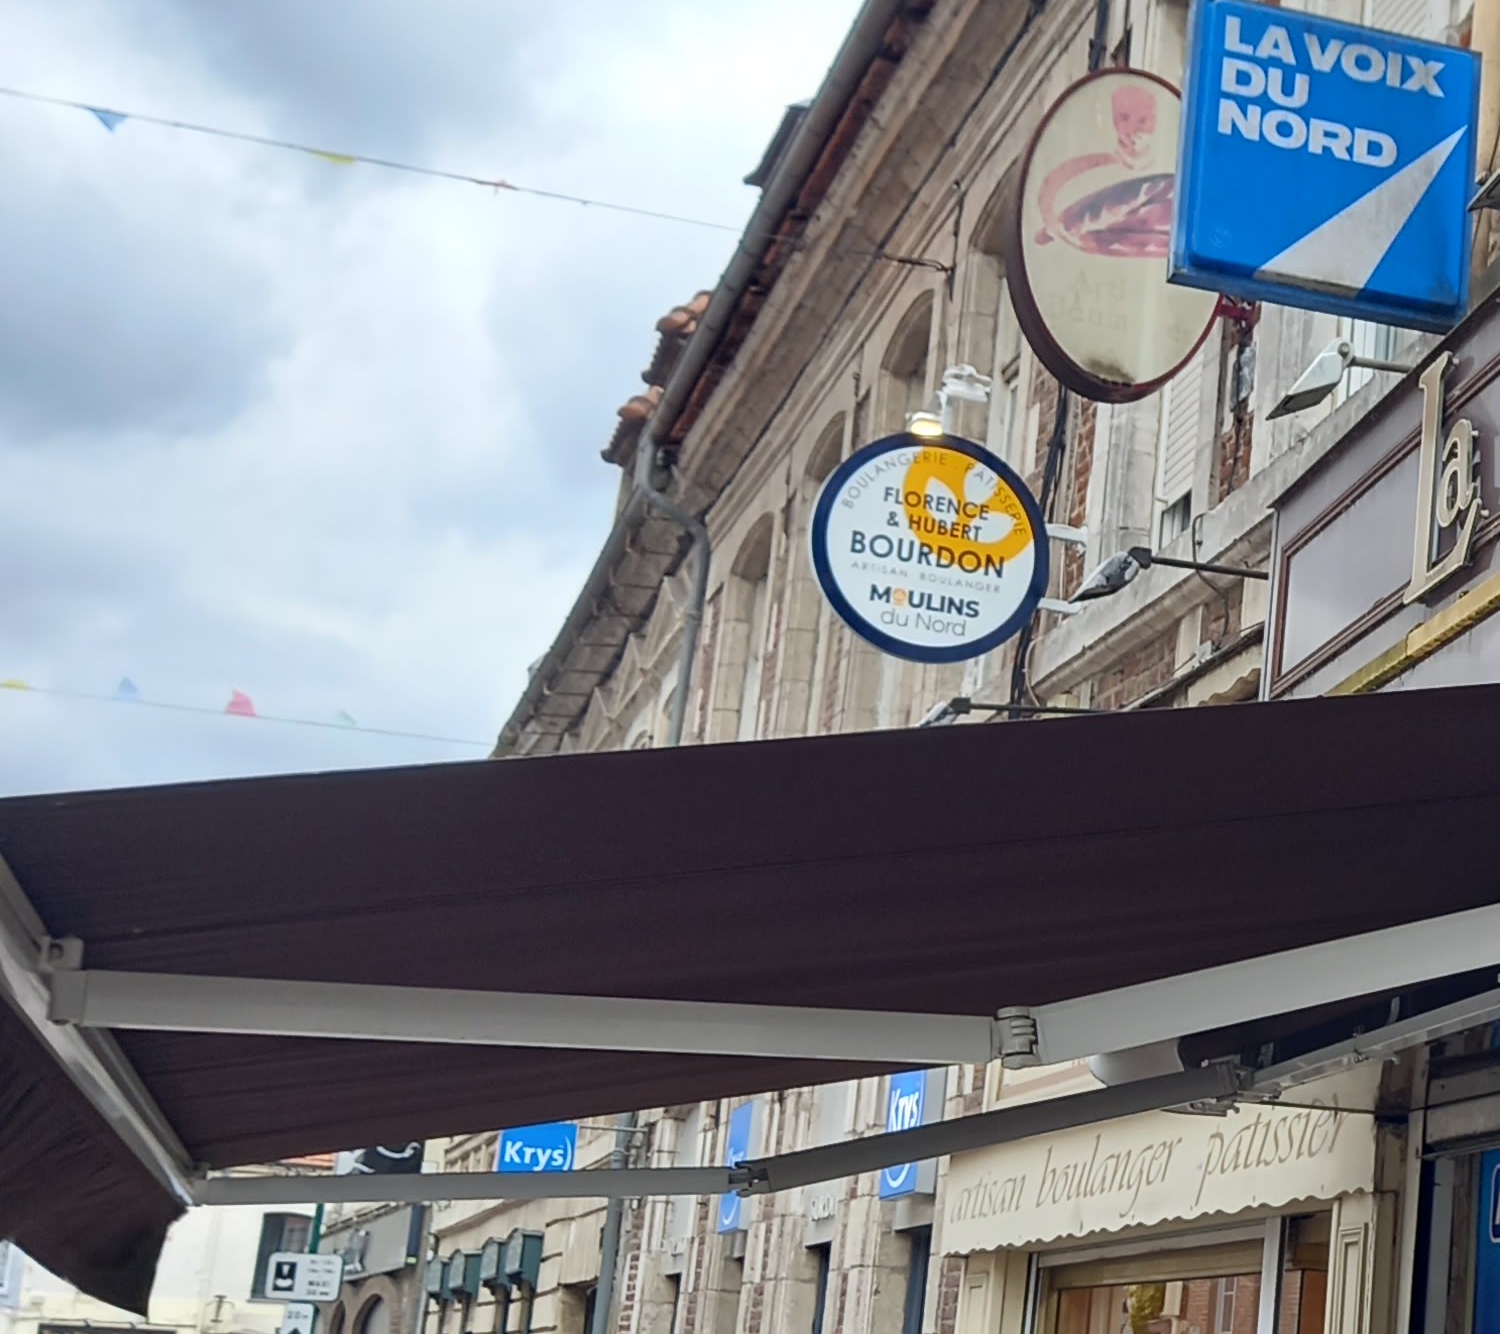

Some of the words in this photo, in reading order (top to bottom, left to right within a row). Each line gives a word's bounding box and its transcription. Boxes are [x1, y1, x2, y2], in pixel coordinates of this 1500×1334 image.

[1225, 15, 1300, 67] LA
[1304, 33, 1446, 99] VOIX
[1221, 57, 1310, 109] DU
[1216, 99, 1399, 168] NORD
[841, 451, 948, 509] BOULANGERIE
[1404, 350, 1484, 605] La
[884, 486, 990, 521] FLORENCE
[887, 511, 899, 527] &
[909, 514, 983, 542] HUBERT
[850, 530, 1005, 579] BOURDON
[851, 560, 908, 578] ARTISAN
[919, 571, 1001, 594] BOULANGER
[869, 584, 980, 619] MOULINS
[880, 608, 908, 627] du
[915, 613, 967, 637] Nord
[504, 1140, 565, 1171] Krys
[950, 1169, 1027, 1224] artisan
[1035, 1133, 1183, 1218] boulanger
